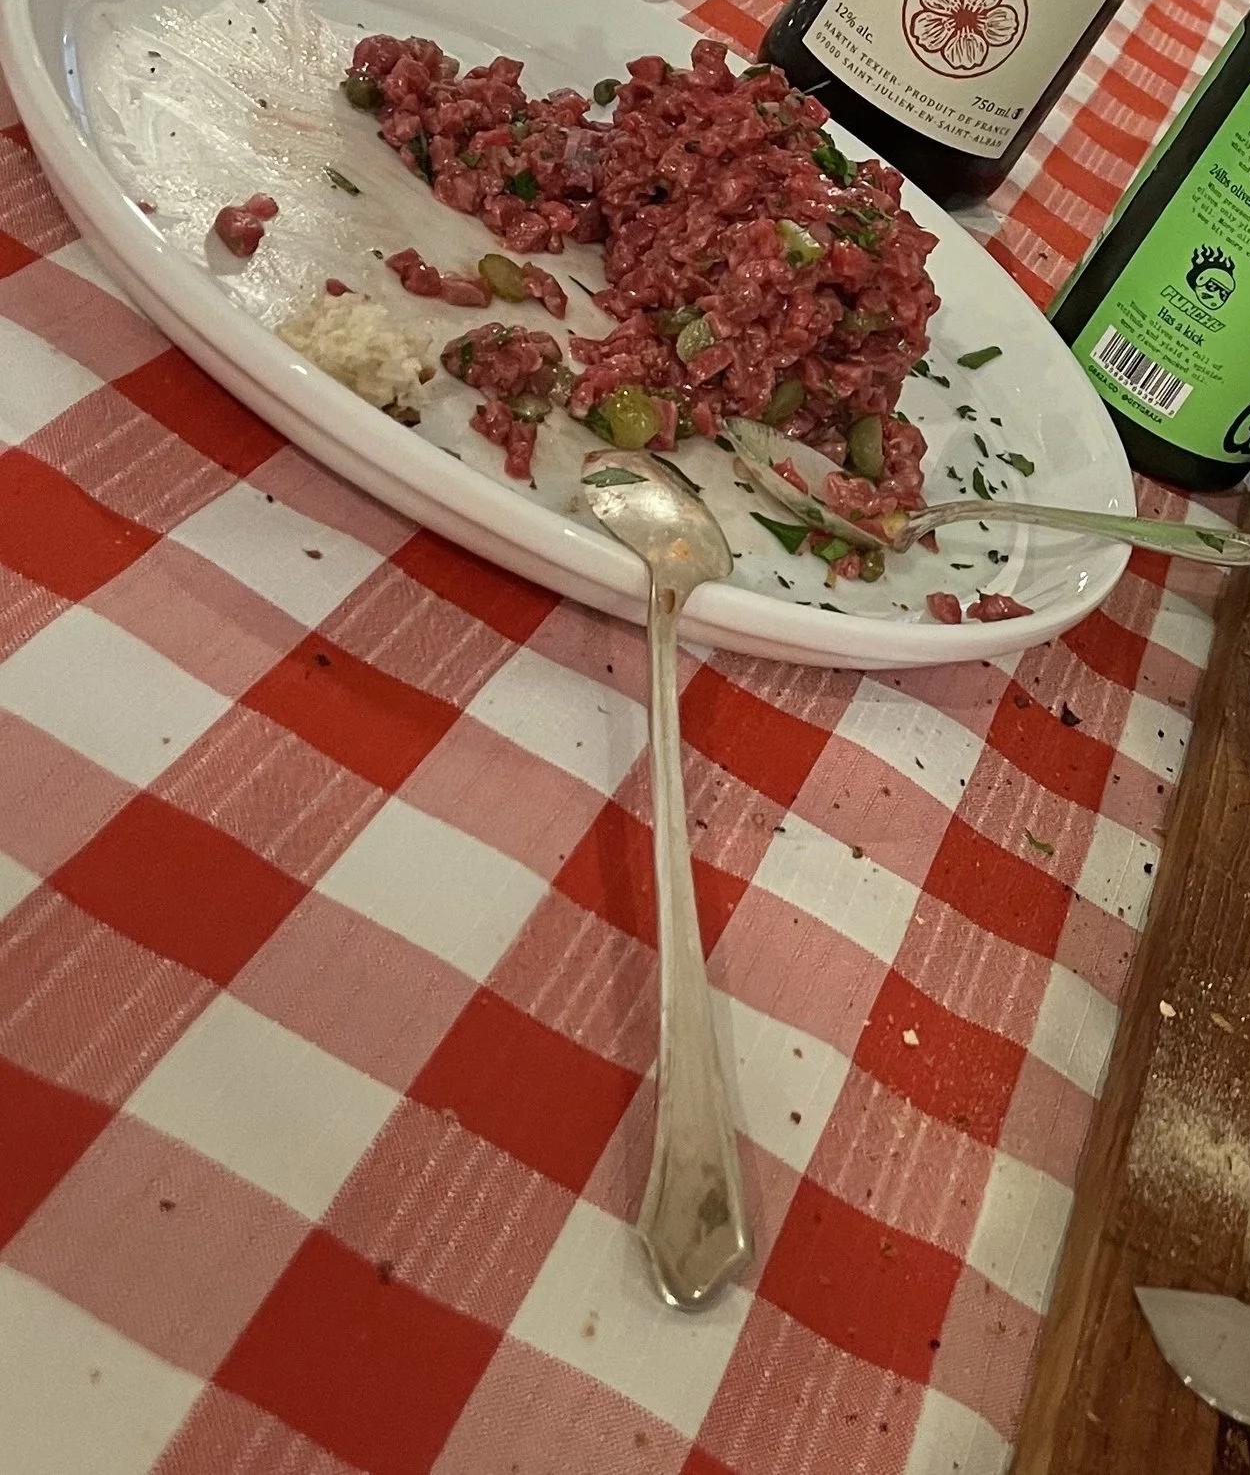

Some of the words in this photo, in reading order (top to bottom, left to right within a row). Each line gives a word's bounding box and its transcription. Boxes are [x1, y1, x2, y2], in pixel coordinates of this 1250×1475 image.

[835, 2, 857, 28] 12%
[856, 25, 873, 44] alc.
[816, 32, 841, 58] 07000
[824, 20, 858, 54] MARTIN
[904, 85, 956, 117] PRODUIT
[957, 113, 973, 124] DE
[973, 120, 1011, 136] FRANCE
[971, 96, 995, 112] 750
[1209, 163, 1231, 188] 24lbs
[1157, 306, 1176, 326] Has
[1174, 323, 1183, 332] a
[1182, 324, 1205, 347] kick
